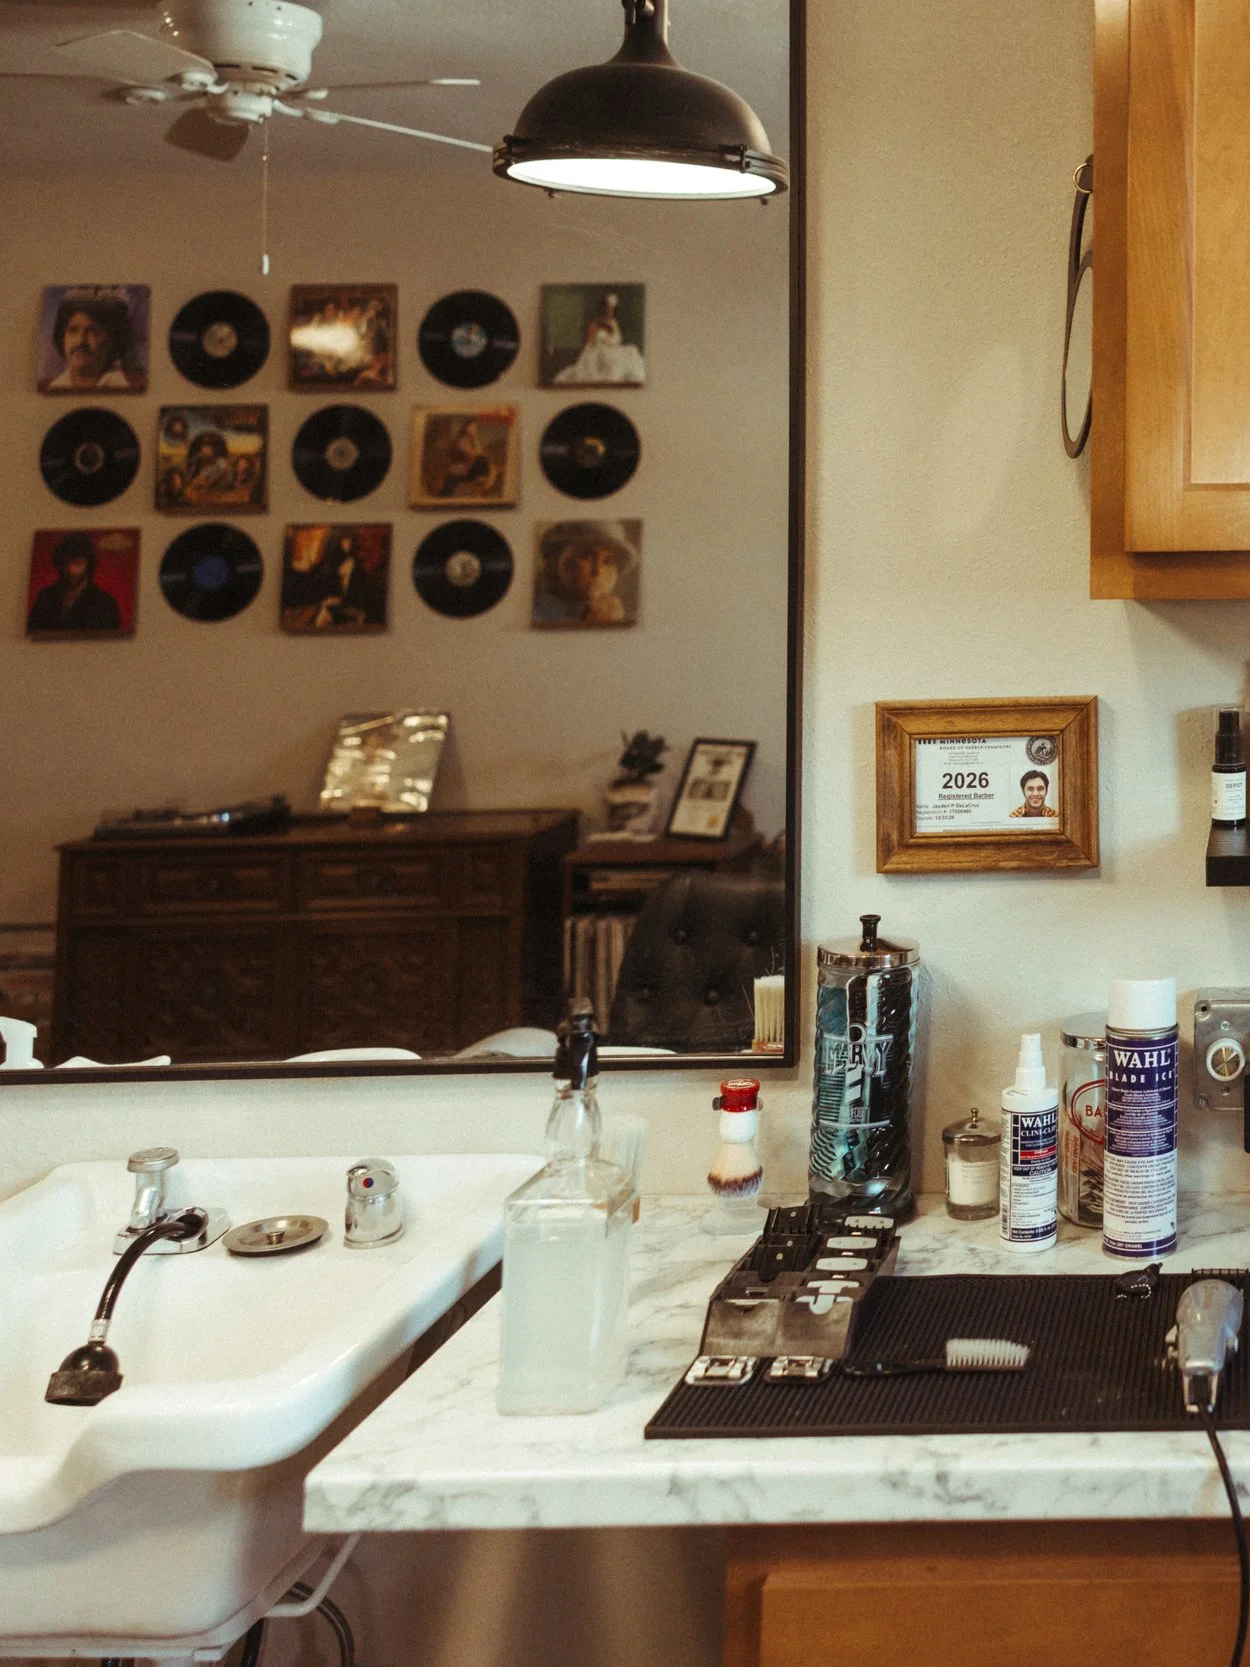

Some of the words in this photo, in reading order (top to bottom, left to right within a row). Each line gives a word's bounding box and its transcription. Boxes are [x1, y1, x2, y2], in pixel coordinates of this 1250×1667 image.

[942, 772, 989, 789] 2026
[973, 792, 994, 800] Barber
[1114, 1050, 1171, 1068] WAHL
[1109, 1070, 1146, 1083] BLADE
[1156, 1070, 1172, 1082] ICE
[1021, 1112, 1057, 1128] WAHL
